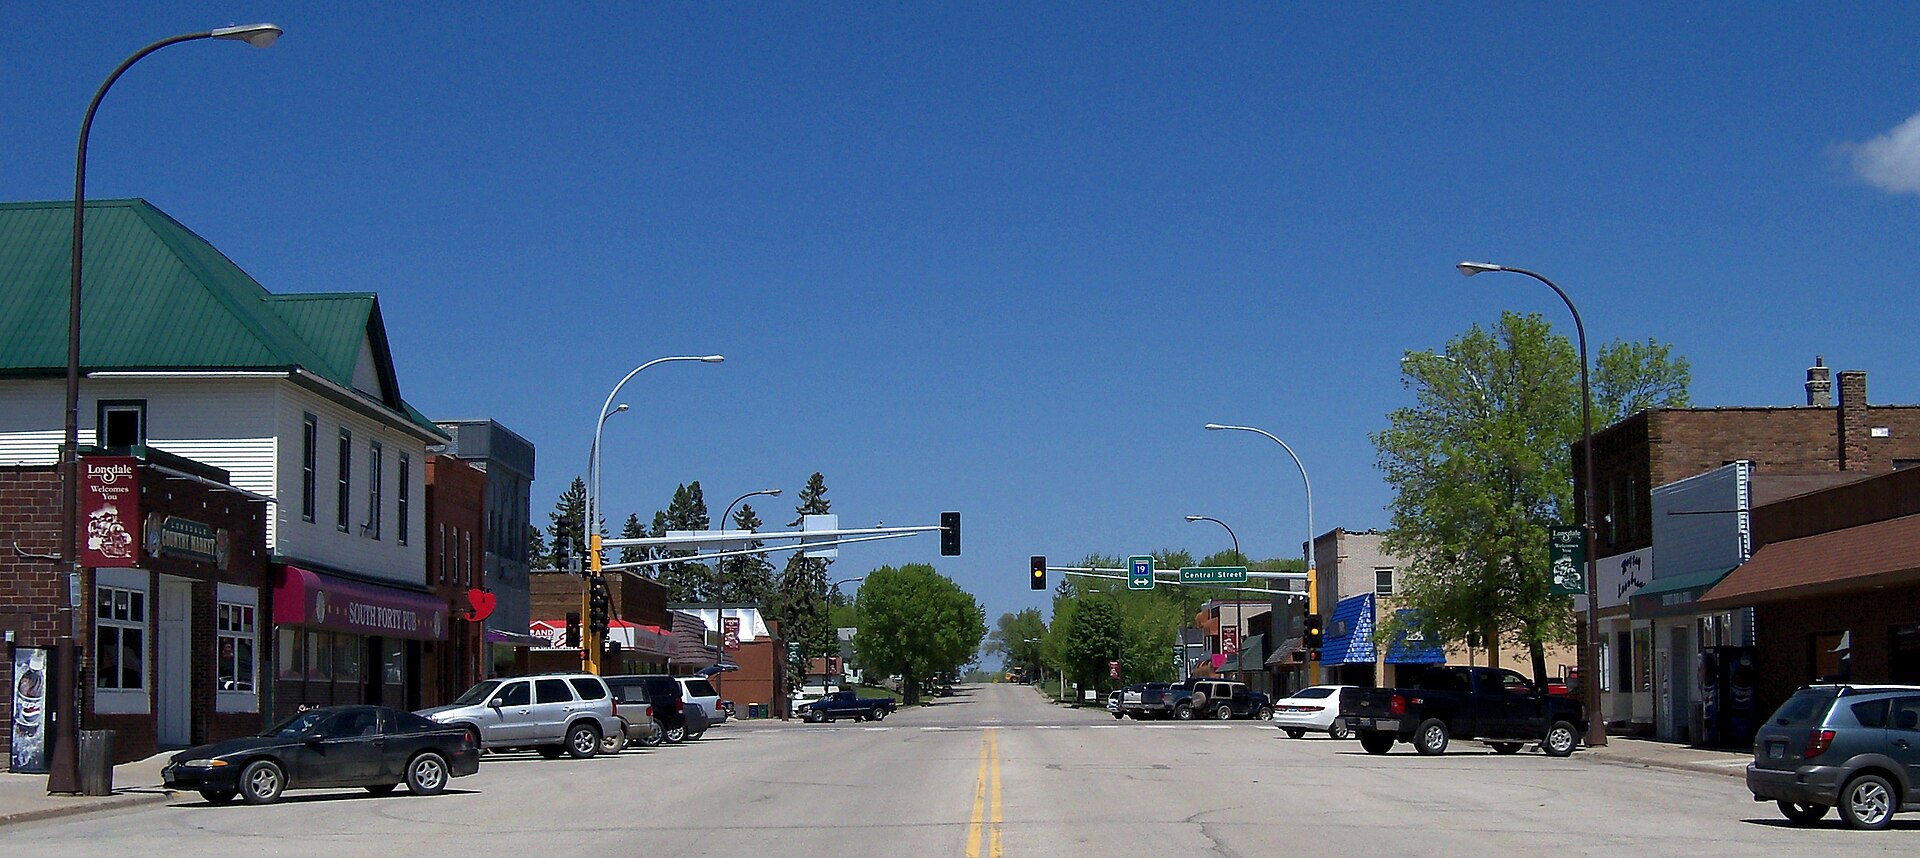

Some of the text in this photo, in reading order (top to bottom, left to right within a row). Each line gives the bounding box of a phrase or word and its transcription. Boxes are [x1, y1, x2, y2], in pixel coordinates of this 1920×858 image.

[87, 464, 132, 482] Lonsdale
[90, 485, 129, 493] Welcomes
[171, 522, 207, 536] LONSDALE
[1553, 530, 1581, 541] Lonsdale
[162, 528, 215, 556] COUNTRY MARKET
[1136, 565, 1146, 573] 19
[348, 602, 417, 632] SOUTH FORTY PUB
[529, 629, 554, 637] RAND
